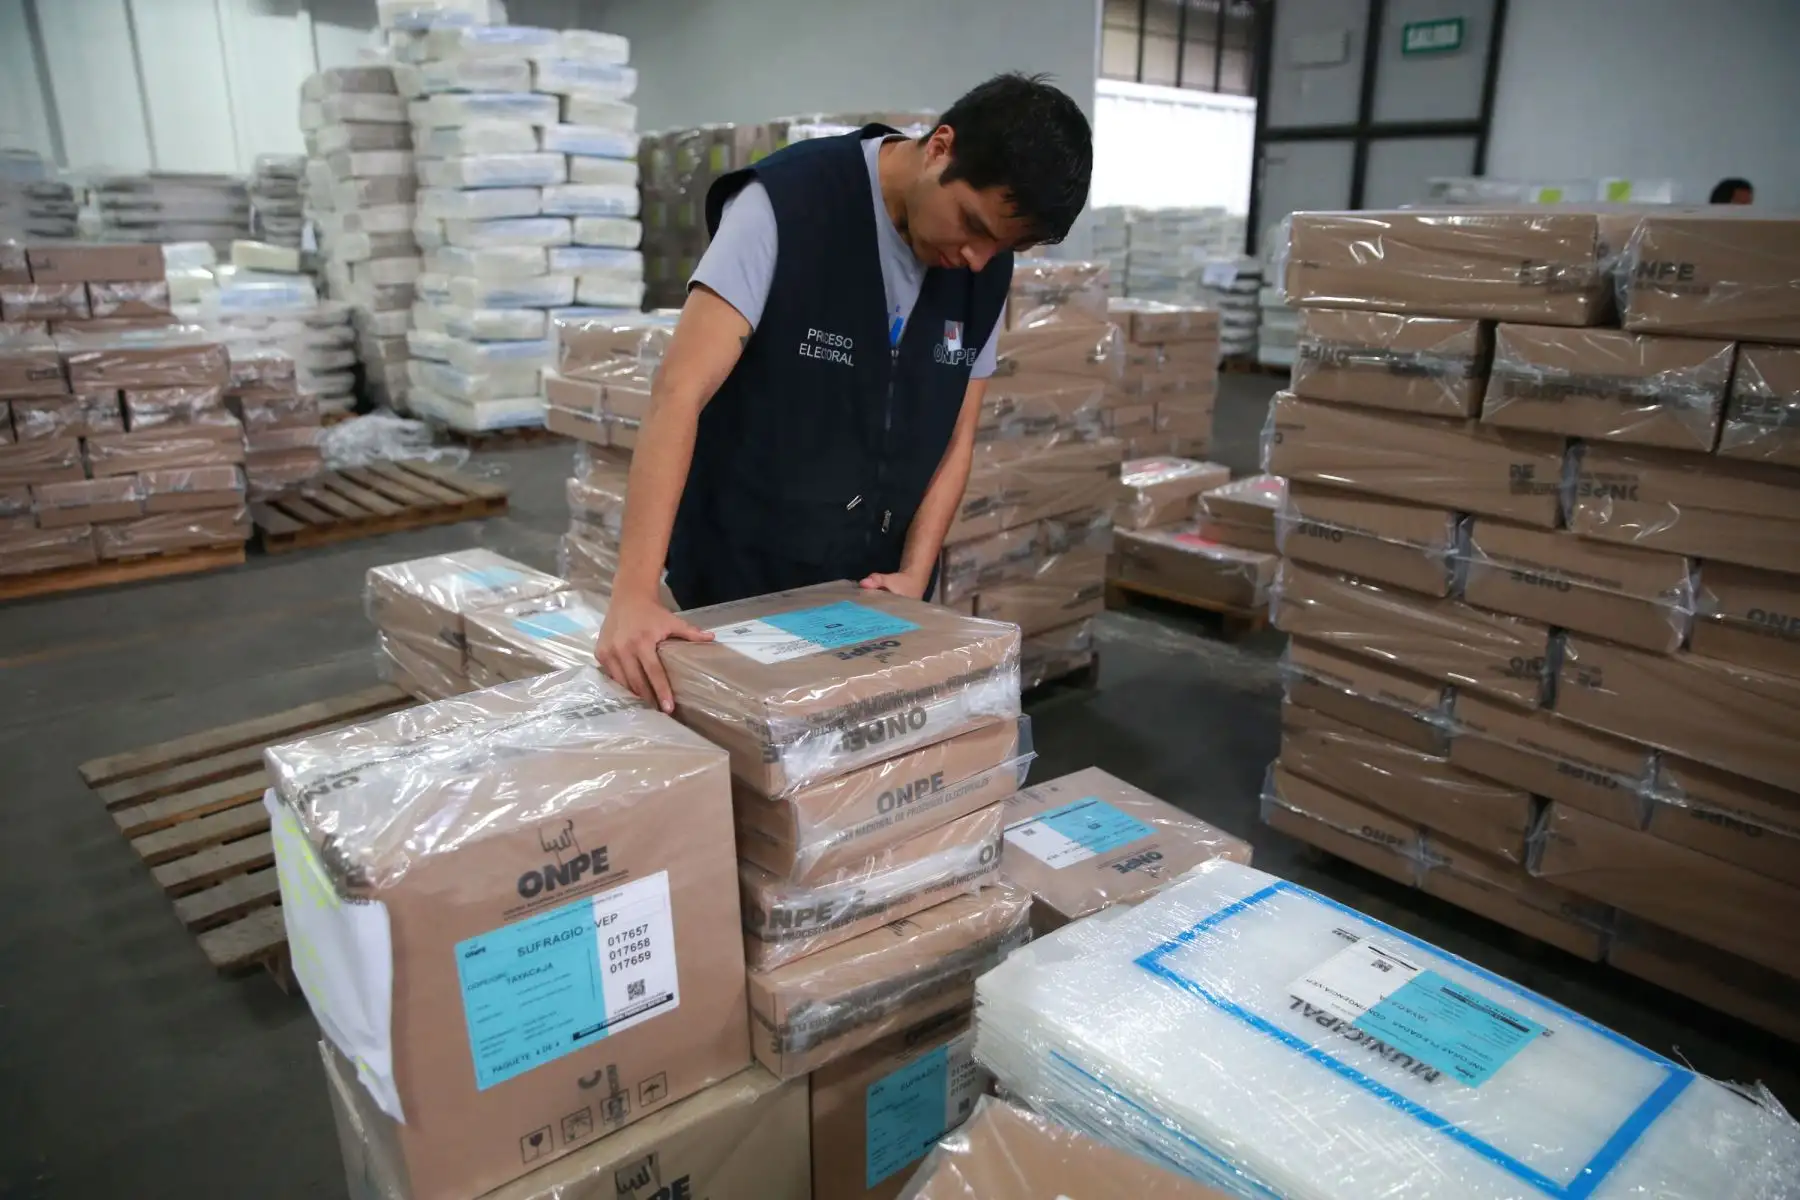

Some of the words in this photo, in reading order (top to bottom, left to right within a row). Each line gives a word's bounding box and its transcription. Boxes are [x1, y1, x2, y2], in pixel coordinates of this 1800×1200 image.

[807, 328, 853, 350] PRCESO
[799, 343, 854, 367] ELECORAL
[934, 344, 976, 367] ONPE
[876, 770, 945, 815] ONPE
[517, 845, 610, 898] ONPE
[517, 926, 584, 957] SUFRAGIO
[594, 913, 619, 928] VEP
[607, 924, 649, 947] 017657
[609, 938, 651, 961] 017658
[507, 962, 554, 985] TAYACAJA
[610, 951, 652, 974] 017659
[1289, 994, 1440, 1083] MUNICIPAL
[492, 1053, 530, 1074] PAQUETE
